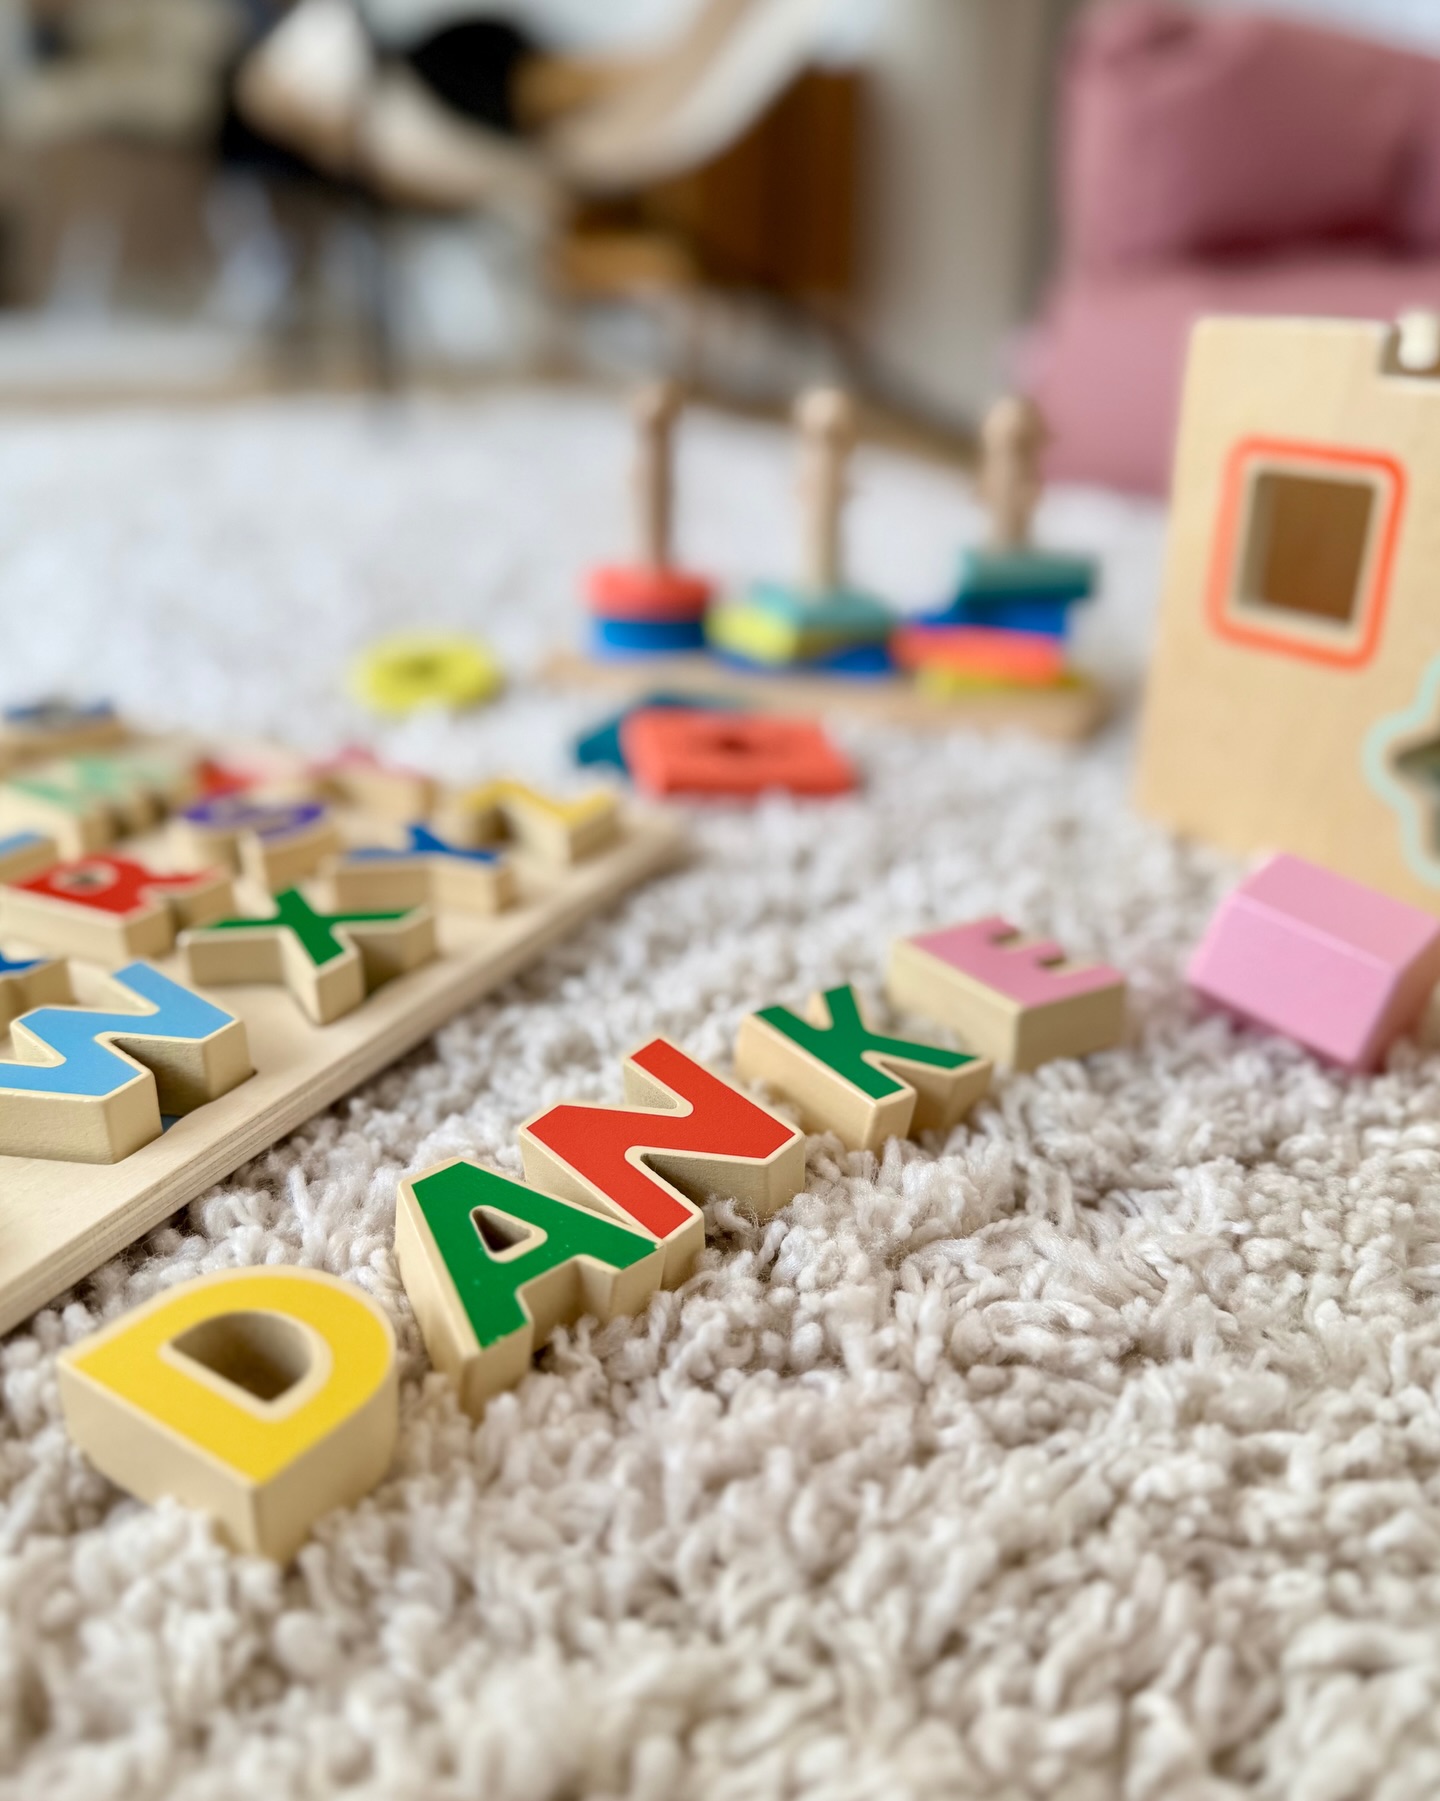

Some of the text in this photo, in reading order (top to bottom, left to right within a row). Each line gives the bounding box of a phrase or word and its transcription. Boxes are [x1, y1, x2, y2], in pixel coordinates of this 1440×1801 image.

[0, 960, 237, 1097] W
[203, 887, 416, 967] X
[66, 914, 1126, 1486] DANKE
